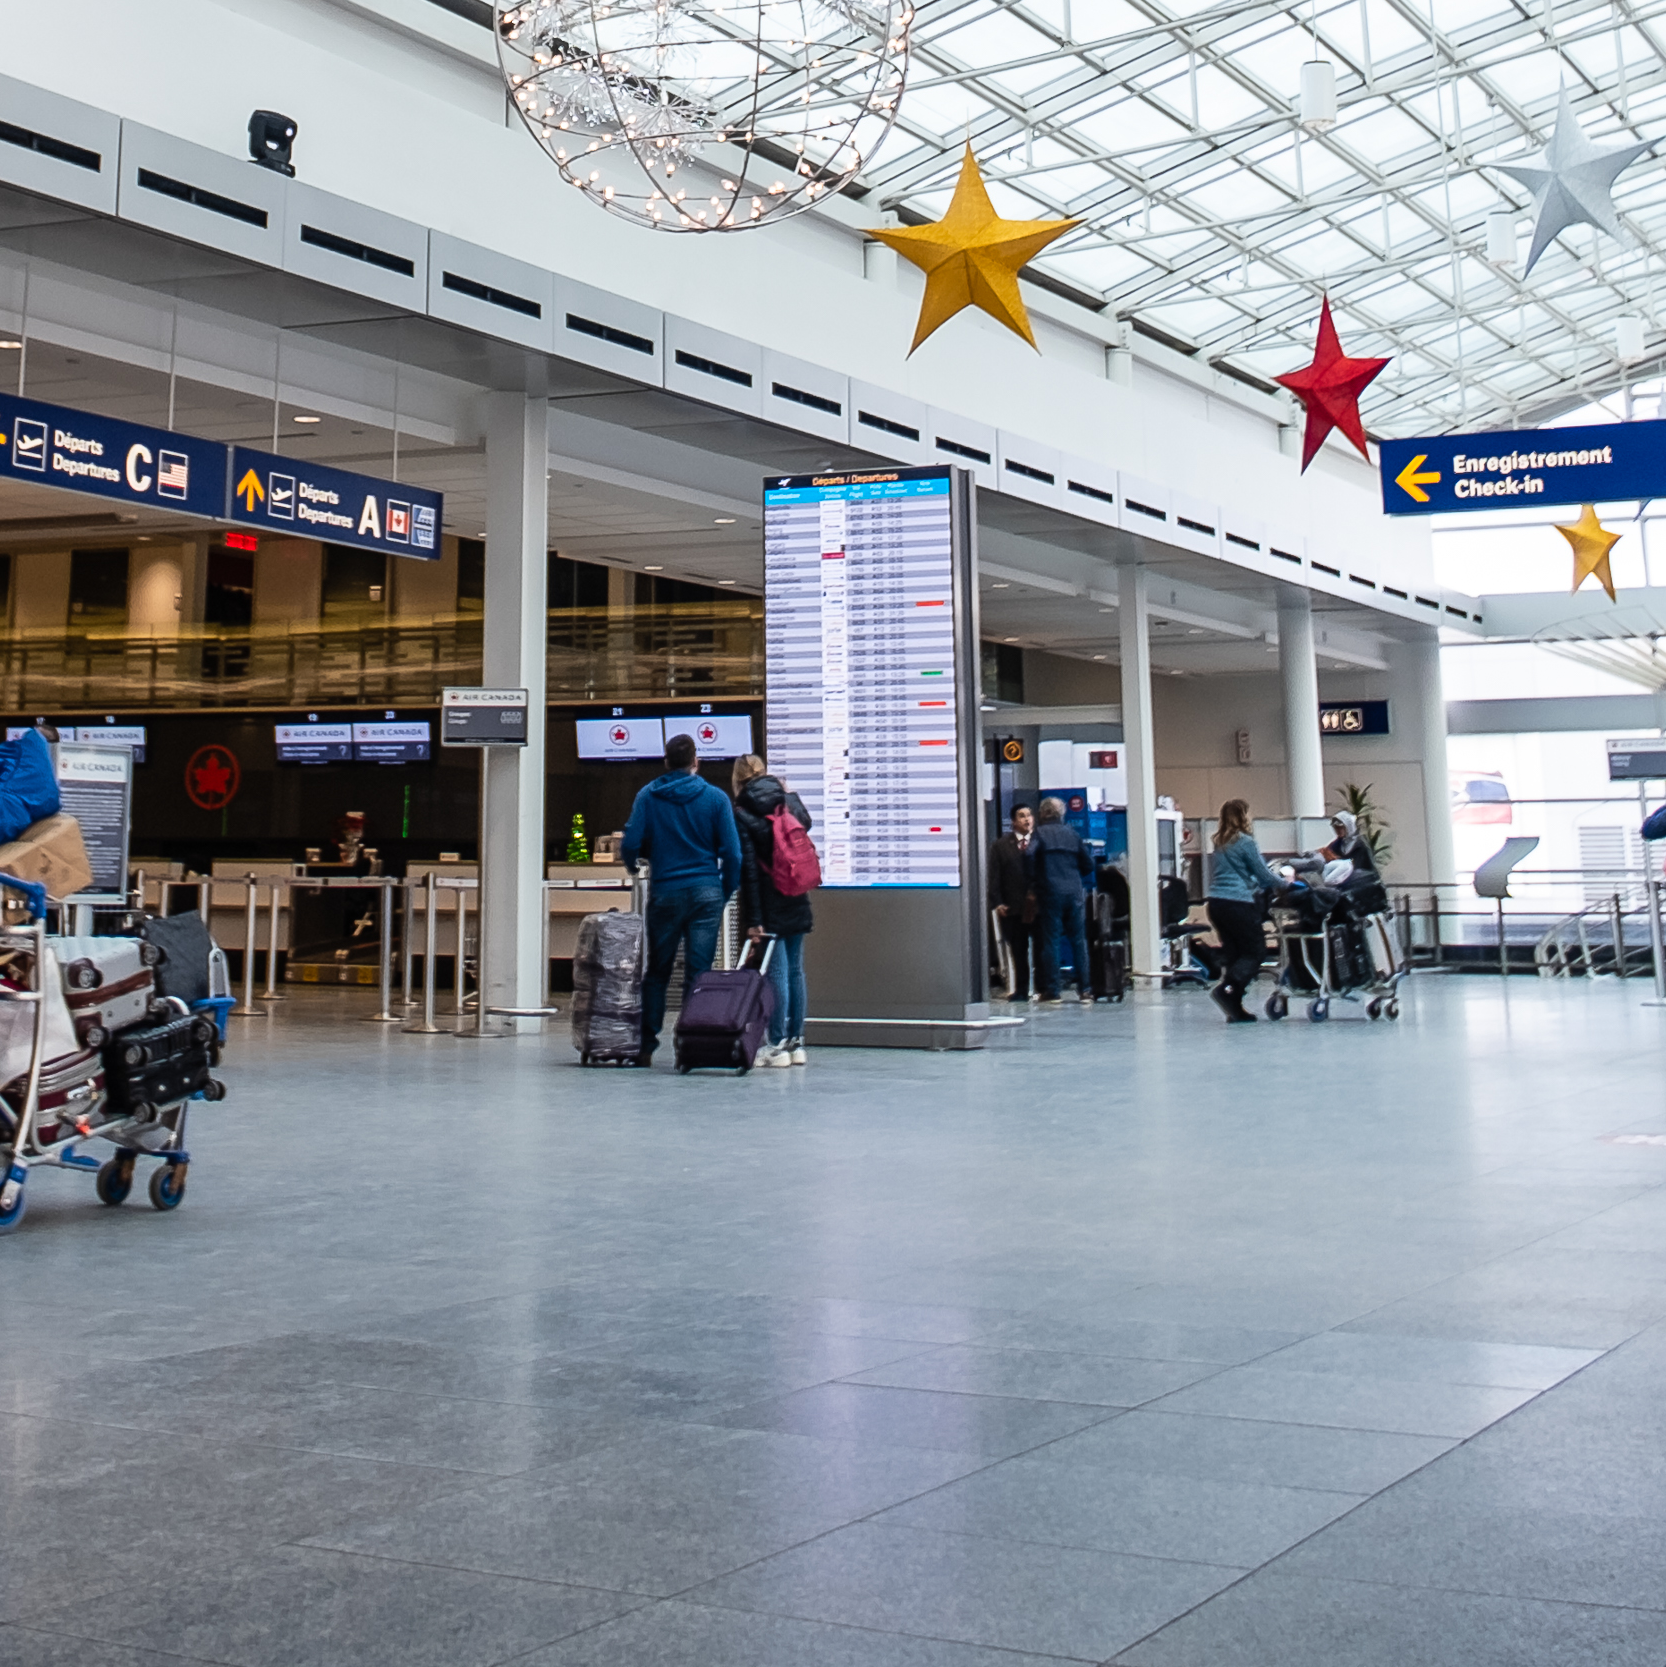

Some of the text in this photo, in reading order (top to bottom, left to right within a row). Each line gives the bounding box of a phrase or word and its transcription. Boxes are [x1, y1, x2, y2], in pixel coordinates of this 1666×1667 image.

[54, 429, 104, 456] Départs
[53, 454, 120, 483] Departures
[125, 444, 153, 492] C
[1453, 444, 1613, 476] Enregistrement
[298, 482, 340, 506] Départs
[1454, 473, 1545, 498] Check-in
[298, 502, 354, 530] Departures
[357, 495, 382, 539] A
